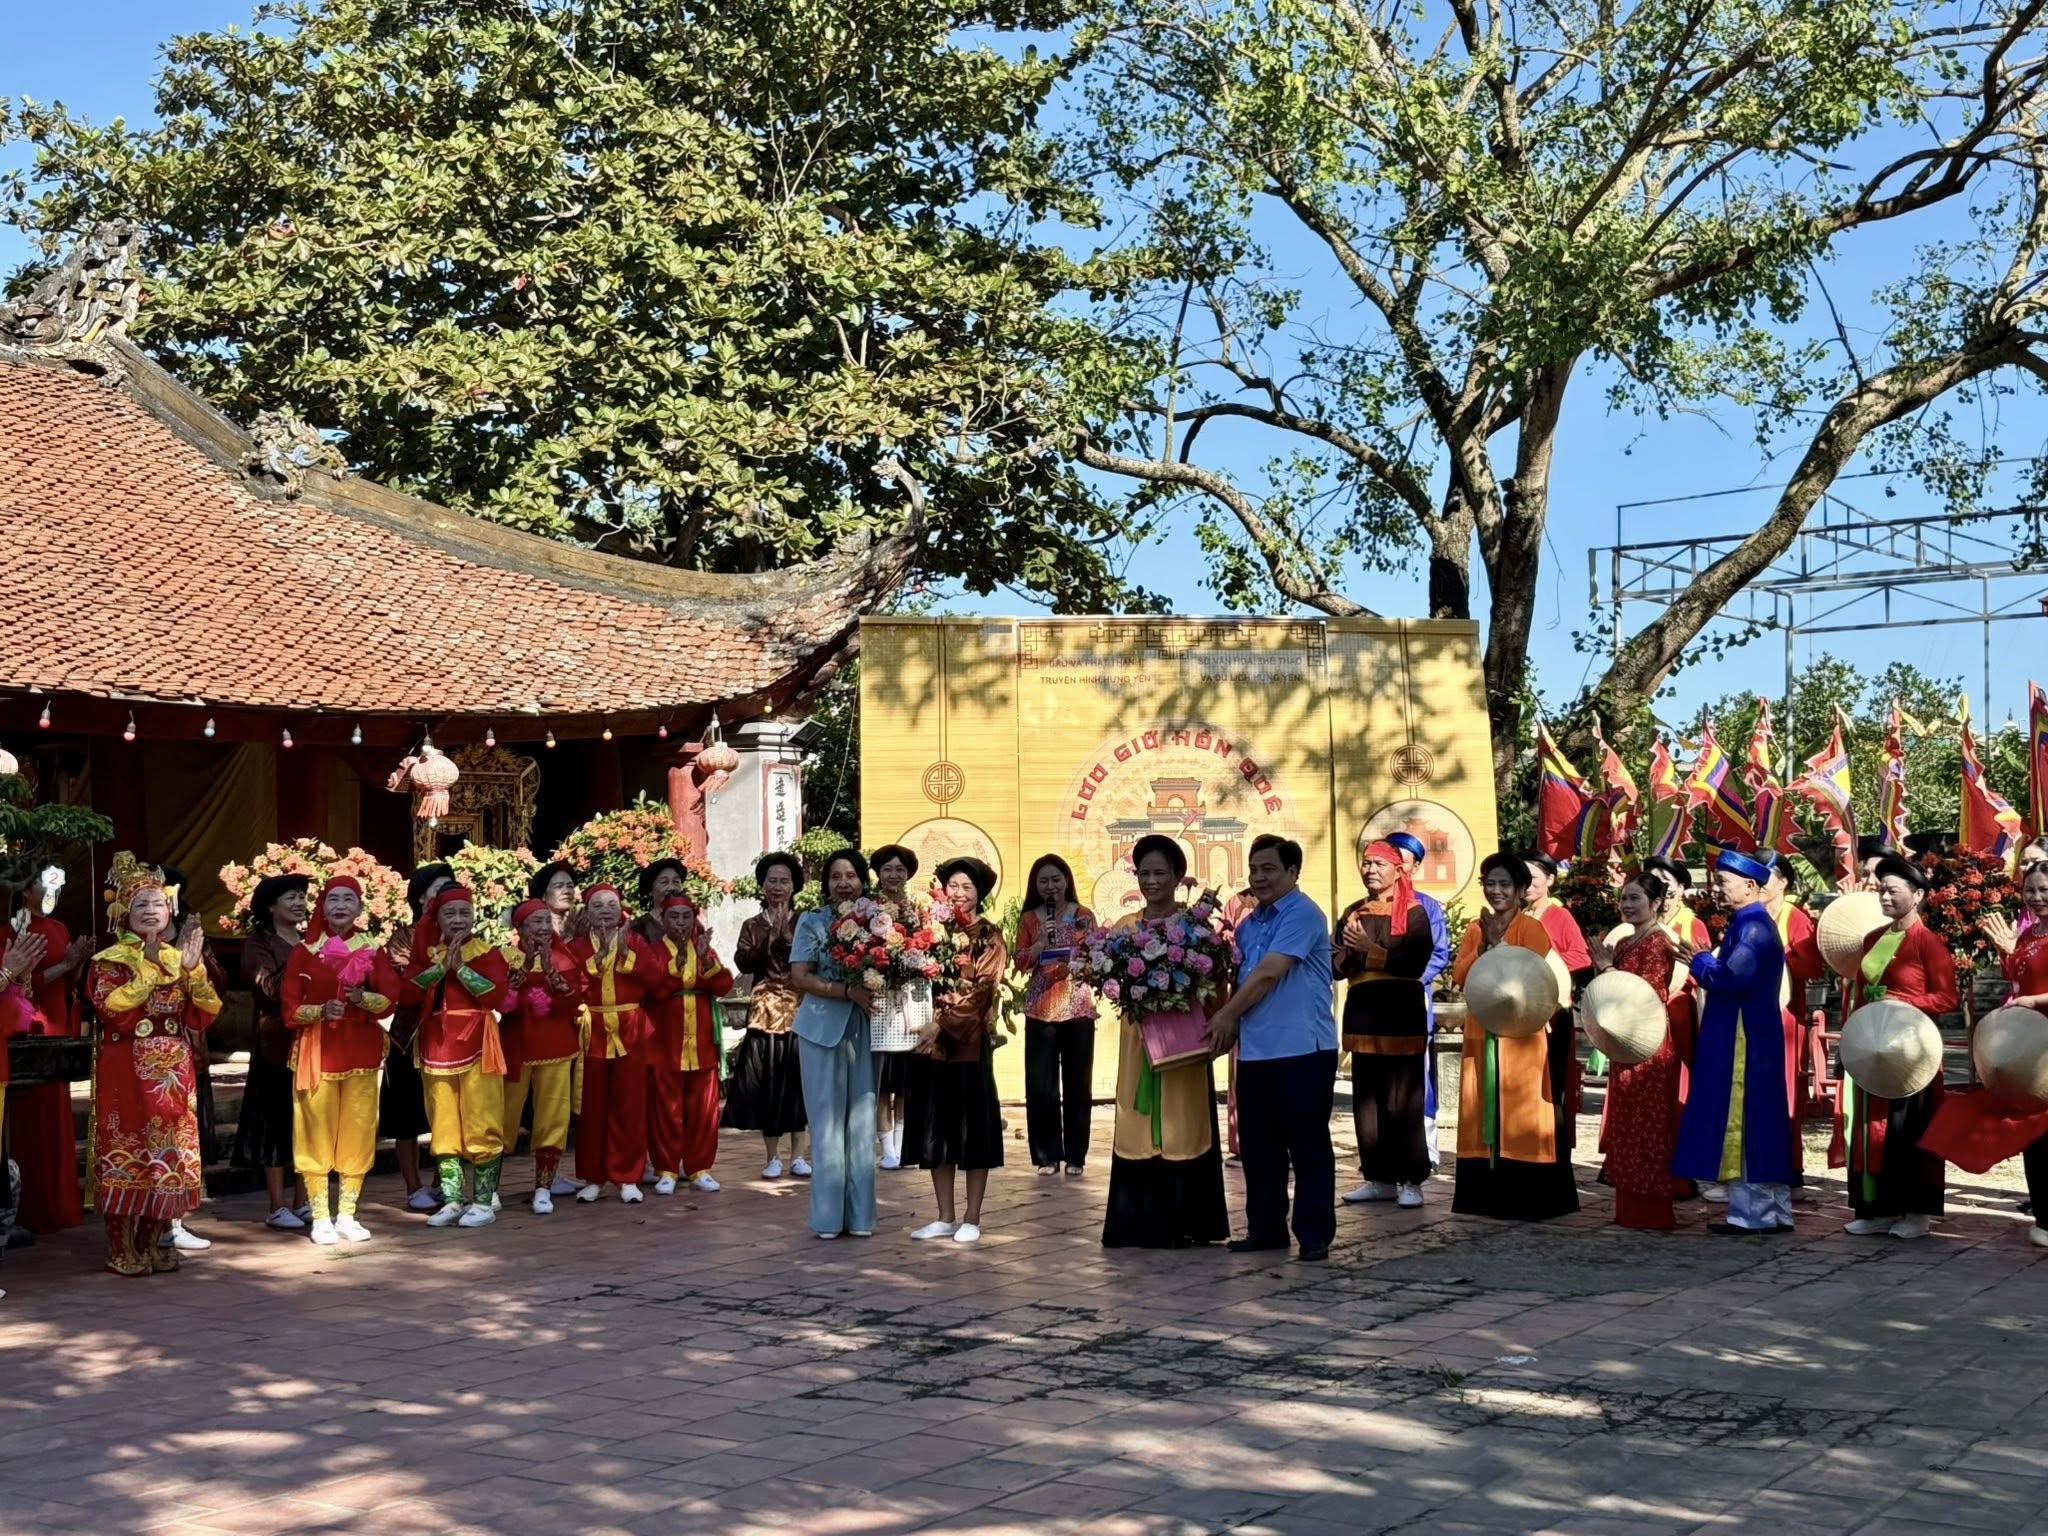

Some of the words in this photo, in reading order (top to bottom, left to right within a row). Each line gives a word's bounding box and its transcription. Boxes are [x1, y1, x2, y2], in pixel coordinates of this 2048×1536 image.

[1071, 763, 1109, 820] LƯU
[1114, 729, 1159, 762] GIỮ
[1239, 757, 1282, 815] QUÊ
[49, 872, 59, 885] 2
